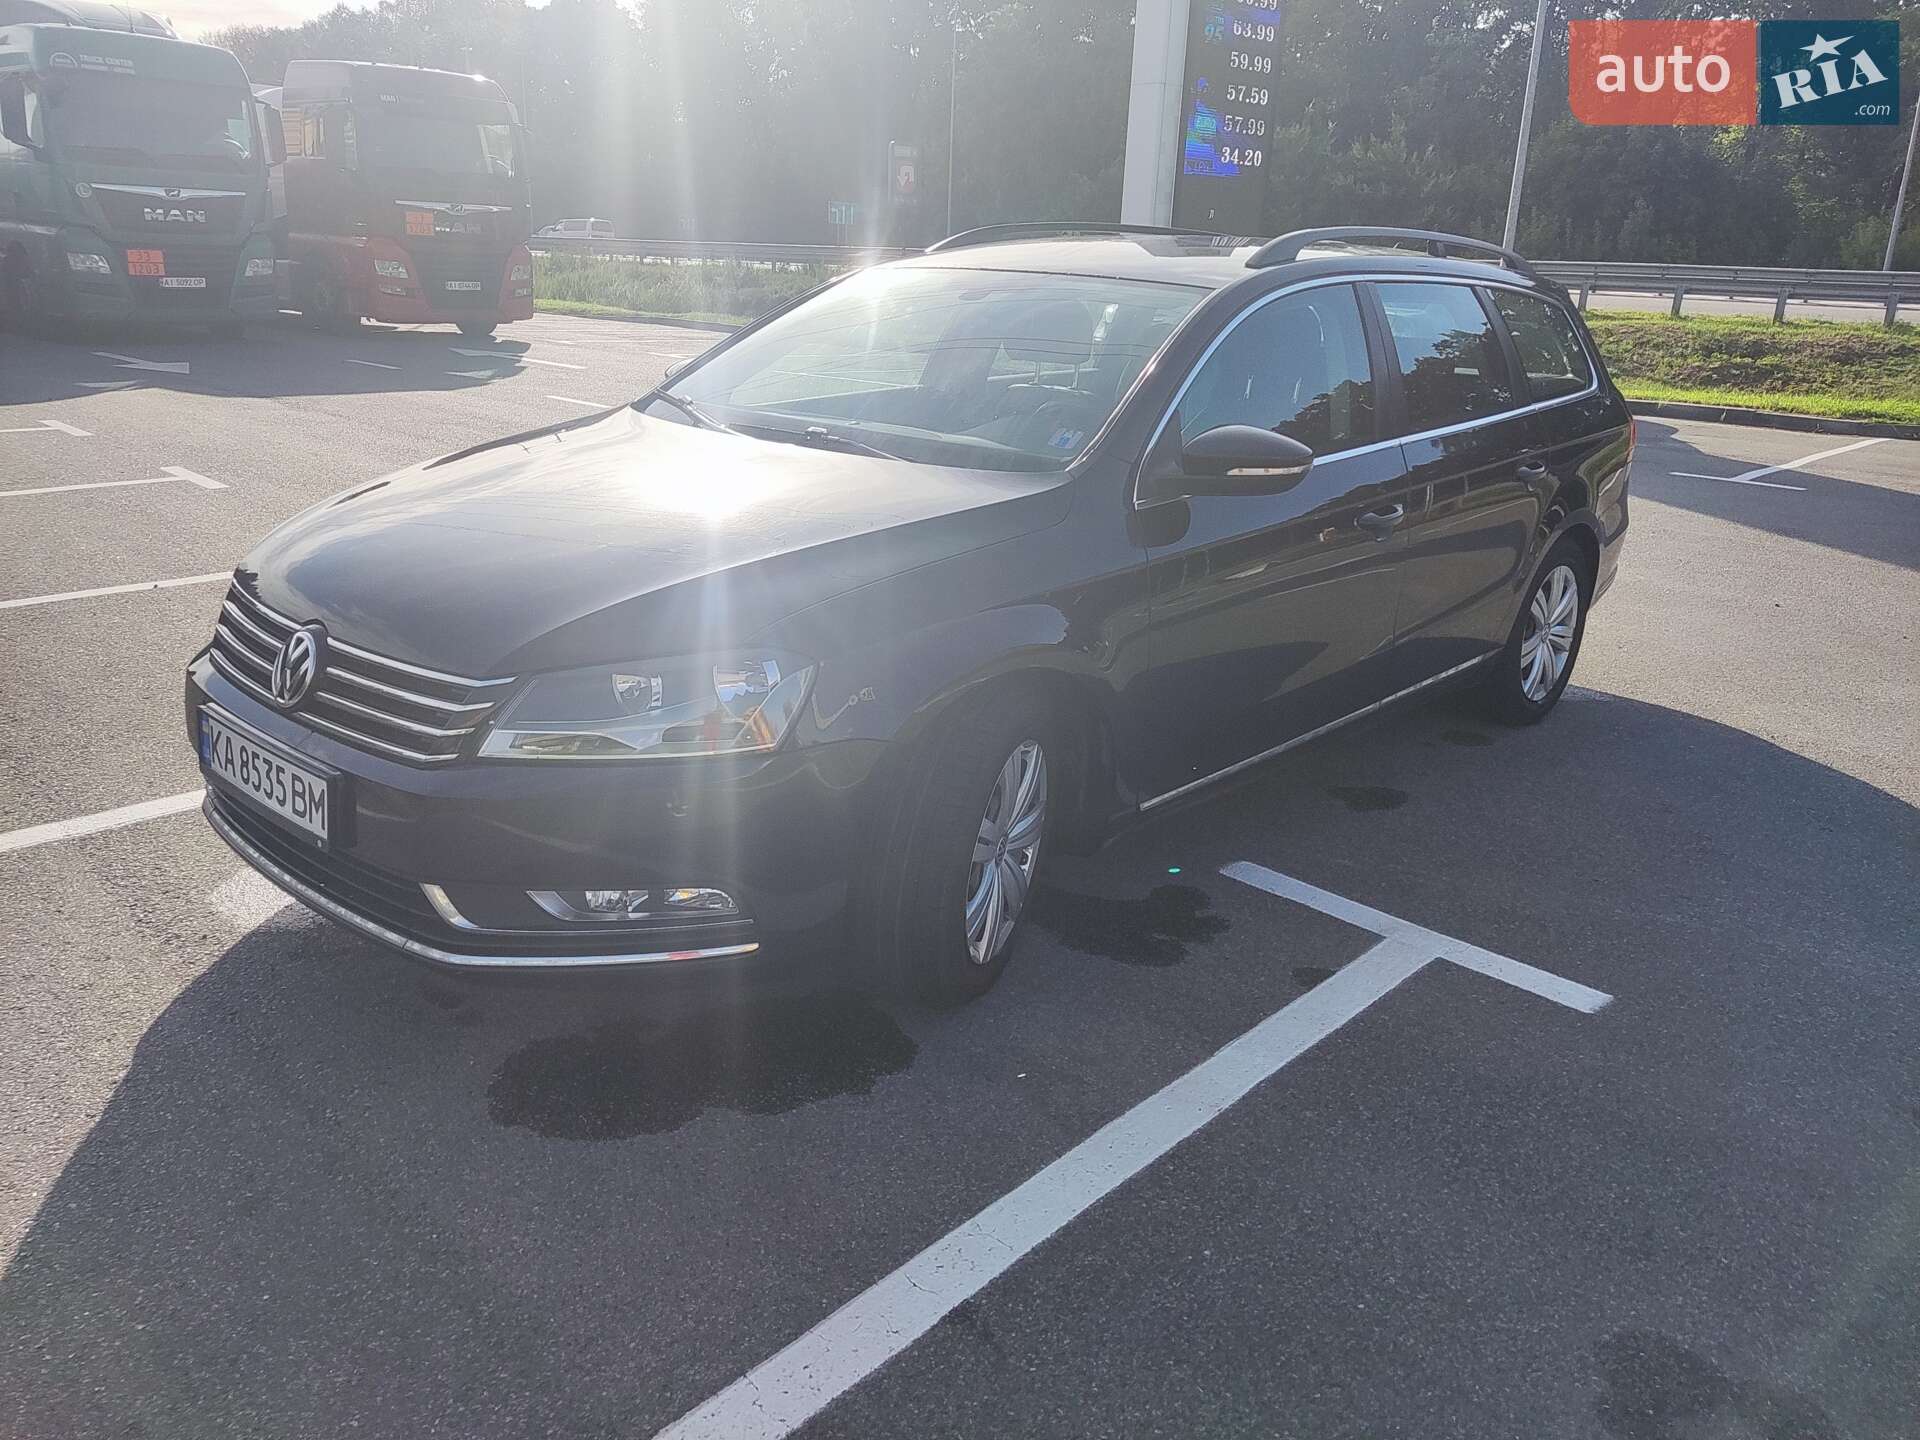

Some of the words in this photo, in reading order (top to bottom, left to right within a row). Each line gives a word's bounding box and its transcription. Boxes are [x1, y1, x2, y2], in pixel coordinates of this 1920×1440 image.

[1233, 20, 1275, 42] 63.99
[1230, 51, 1272, 74] 59.99
[1226, 84, 1269, 105] 57.59
[1223, 115, 1265, 137] 57.99
[1221, 147, 1262, 167] 34.20
[144, 208, 206, 223] MAN
[132, 263, 160, 275] 1203
